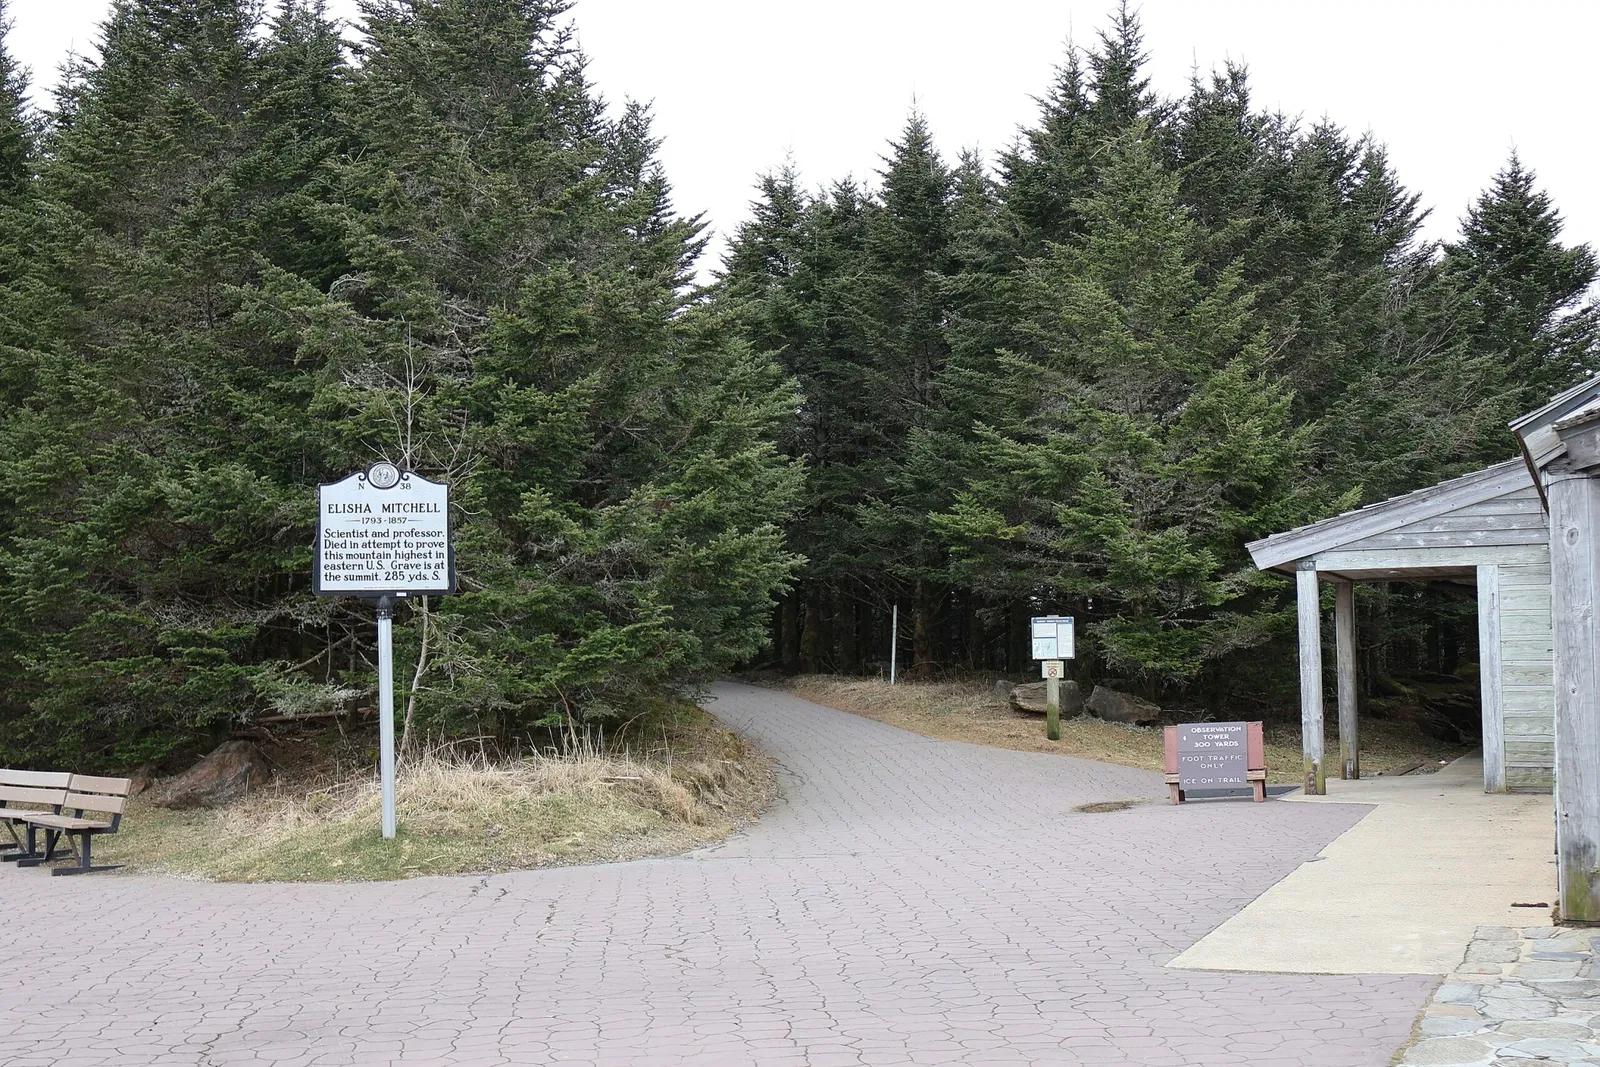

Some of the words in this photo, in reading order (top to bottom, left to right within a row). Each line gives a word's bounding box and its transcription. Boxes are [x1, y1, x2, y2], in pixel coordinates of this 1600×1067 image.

[328, 503, 372, 513] ELISHA
[382, 503, 440, 513] MITCHELL
[324, 528, 368, 538] Scientist
[371, 529, 389, 538] and
[393, 528, 444, 539] professor.
[324, 540, 347, 549] Died
[361, 541, 401, 550] attempt
[416, 541, 444, 550] prove
[324, 551, 343, 560] this
[345, 551, 391, 559] mountain
[395, 550, 432, 561] highest
[324, 562, 363, 570] eastern
[366, 560, 385, 570] U.S.
[391, 560, 421, 570] Grave
[424, 561, 431, 569] is
[434, 561, 444, 569] at
[324, 573, 341, 581] the
[384, 571, 405, 580] 285
[408, 572, 429, 582] yds.
[431, 571, 440, 580] S.
